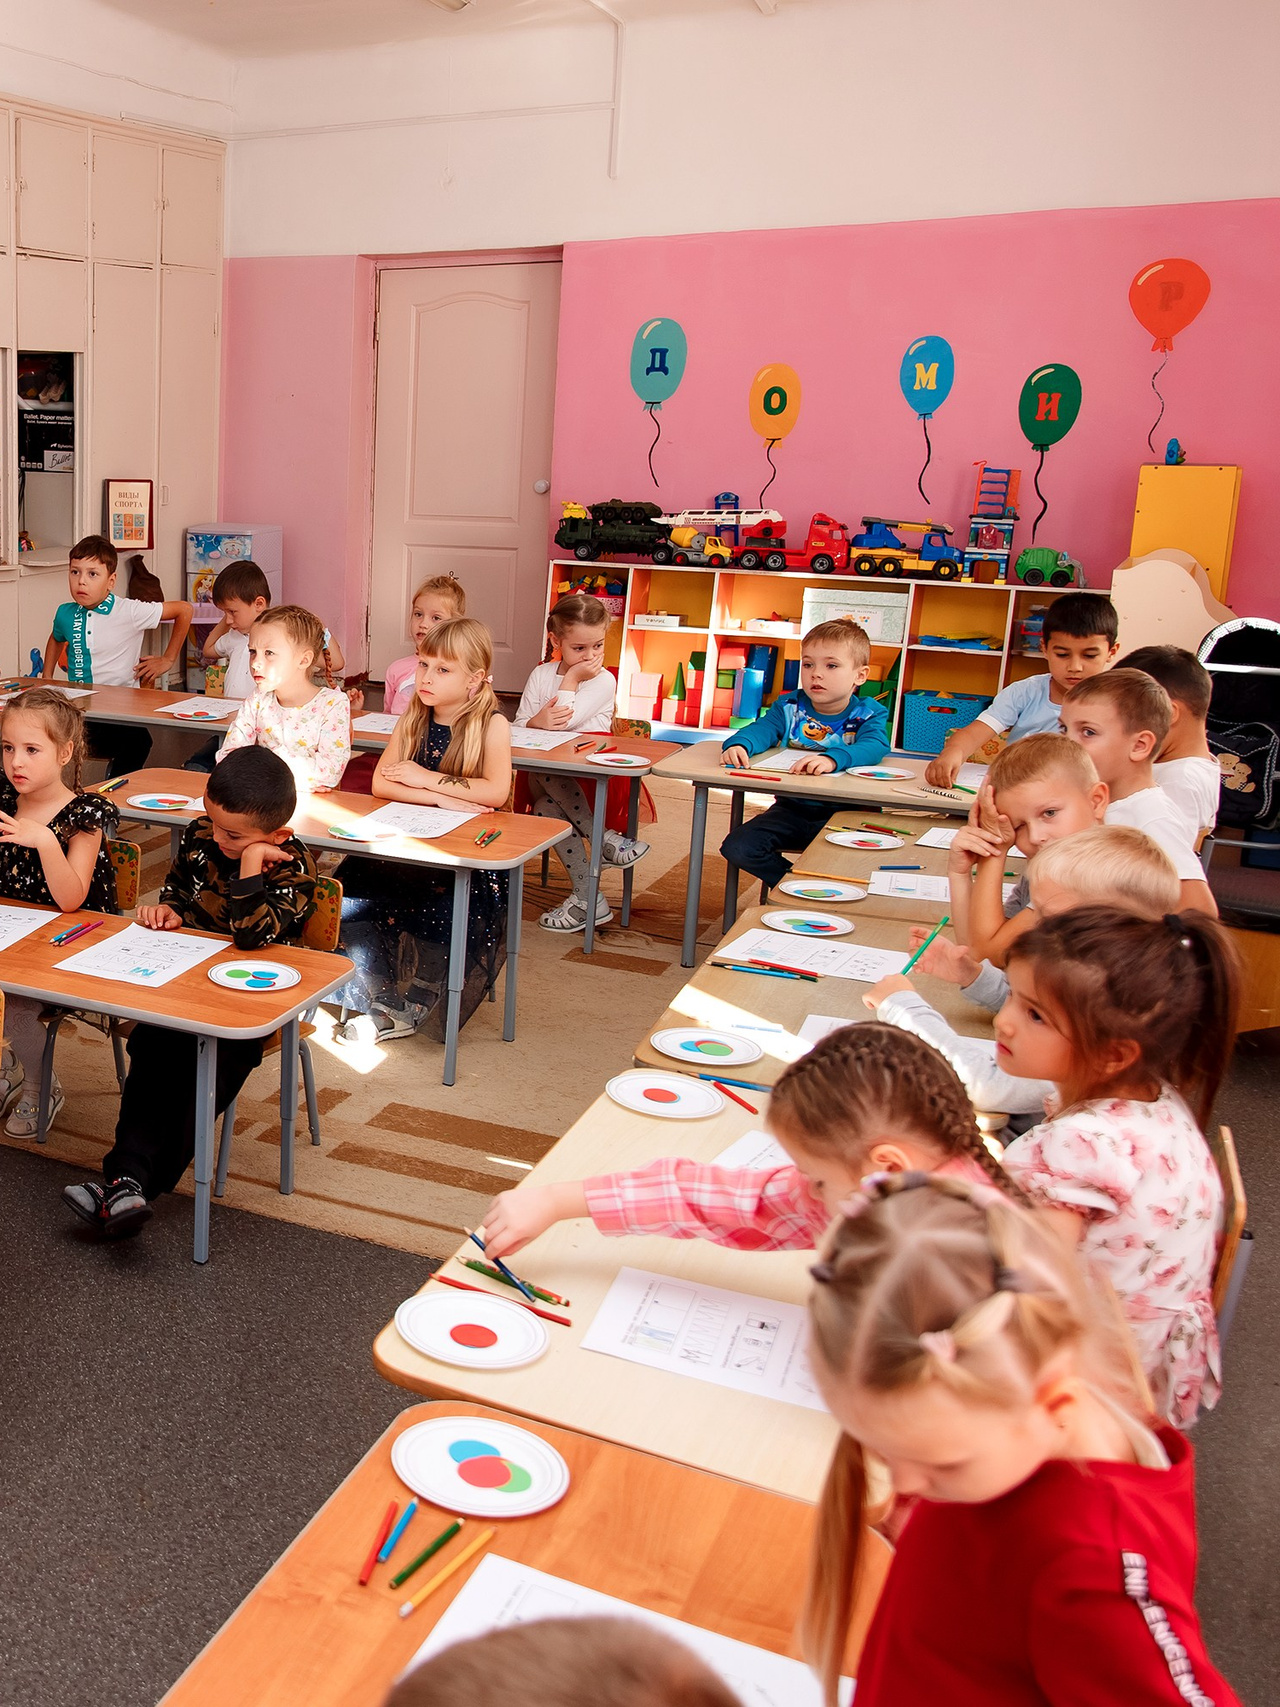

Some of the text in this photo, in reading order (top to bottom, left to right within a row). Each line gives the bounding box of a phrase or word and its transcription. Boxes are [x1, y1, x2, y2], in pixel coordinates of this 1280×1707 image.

[645, 281, 1185, 421] Д О М И Р
[73, 612, 83, 632] STAY
[72, 633, 84, 668] PLUGGED
[74, 669, 83, 678] IN
